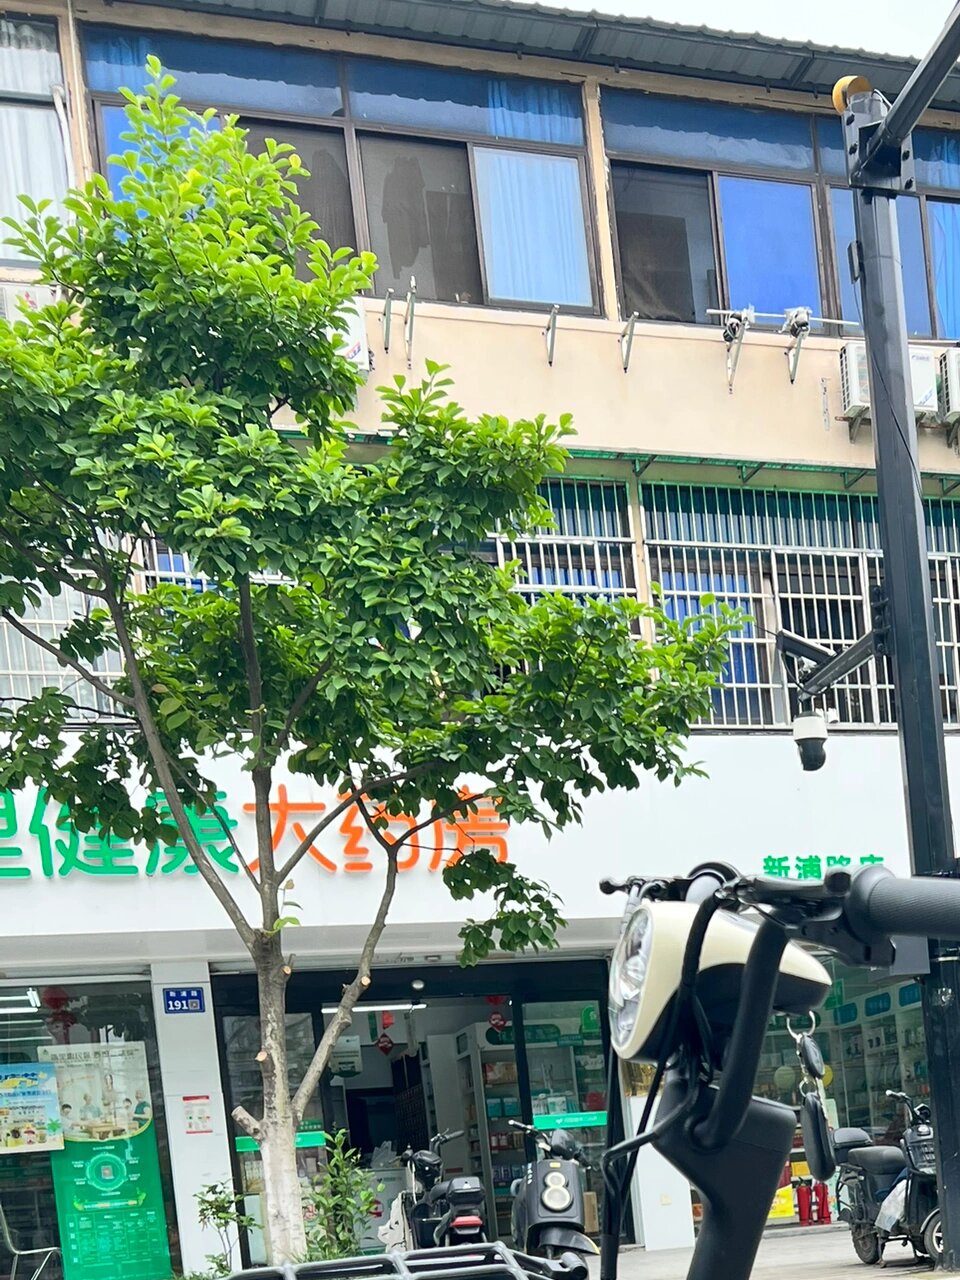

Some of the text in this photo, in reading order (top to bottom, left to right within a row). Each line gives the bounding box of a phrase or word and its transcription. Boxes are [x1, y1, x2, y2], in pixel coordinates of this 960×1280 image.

[0, 783, 510, 878] 健康大药房
[168, 1000, 189, 1010] 191
